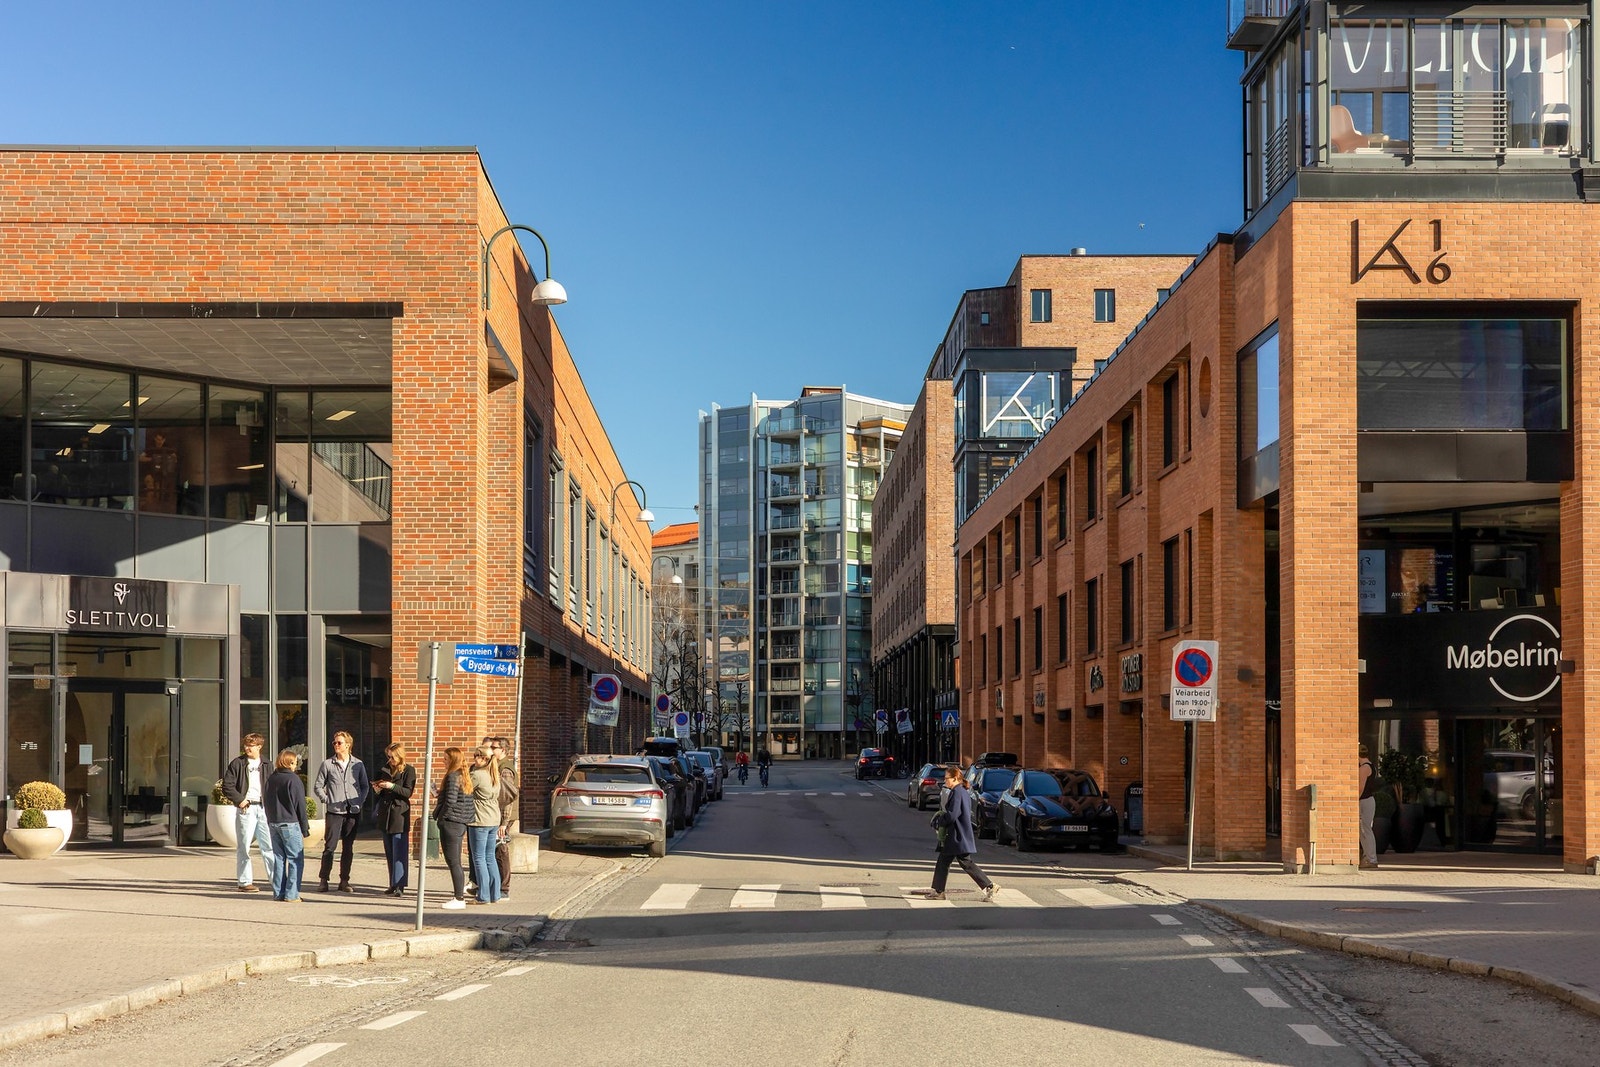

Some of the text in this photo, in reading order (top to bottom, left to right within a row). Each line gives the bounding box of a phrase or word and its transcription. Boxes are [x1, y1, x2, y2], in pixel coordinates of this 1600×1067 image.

[65, 609, 176, 629] SLETTVOLL
[1447, 641, 1562, 669] Møbelrin
[468, 660, 495, 673] Bygdøy
